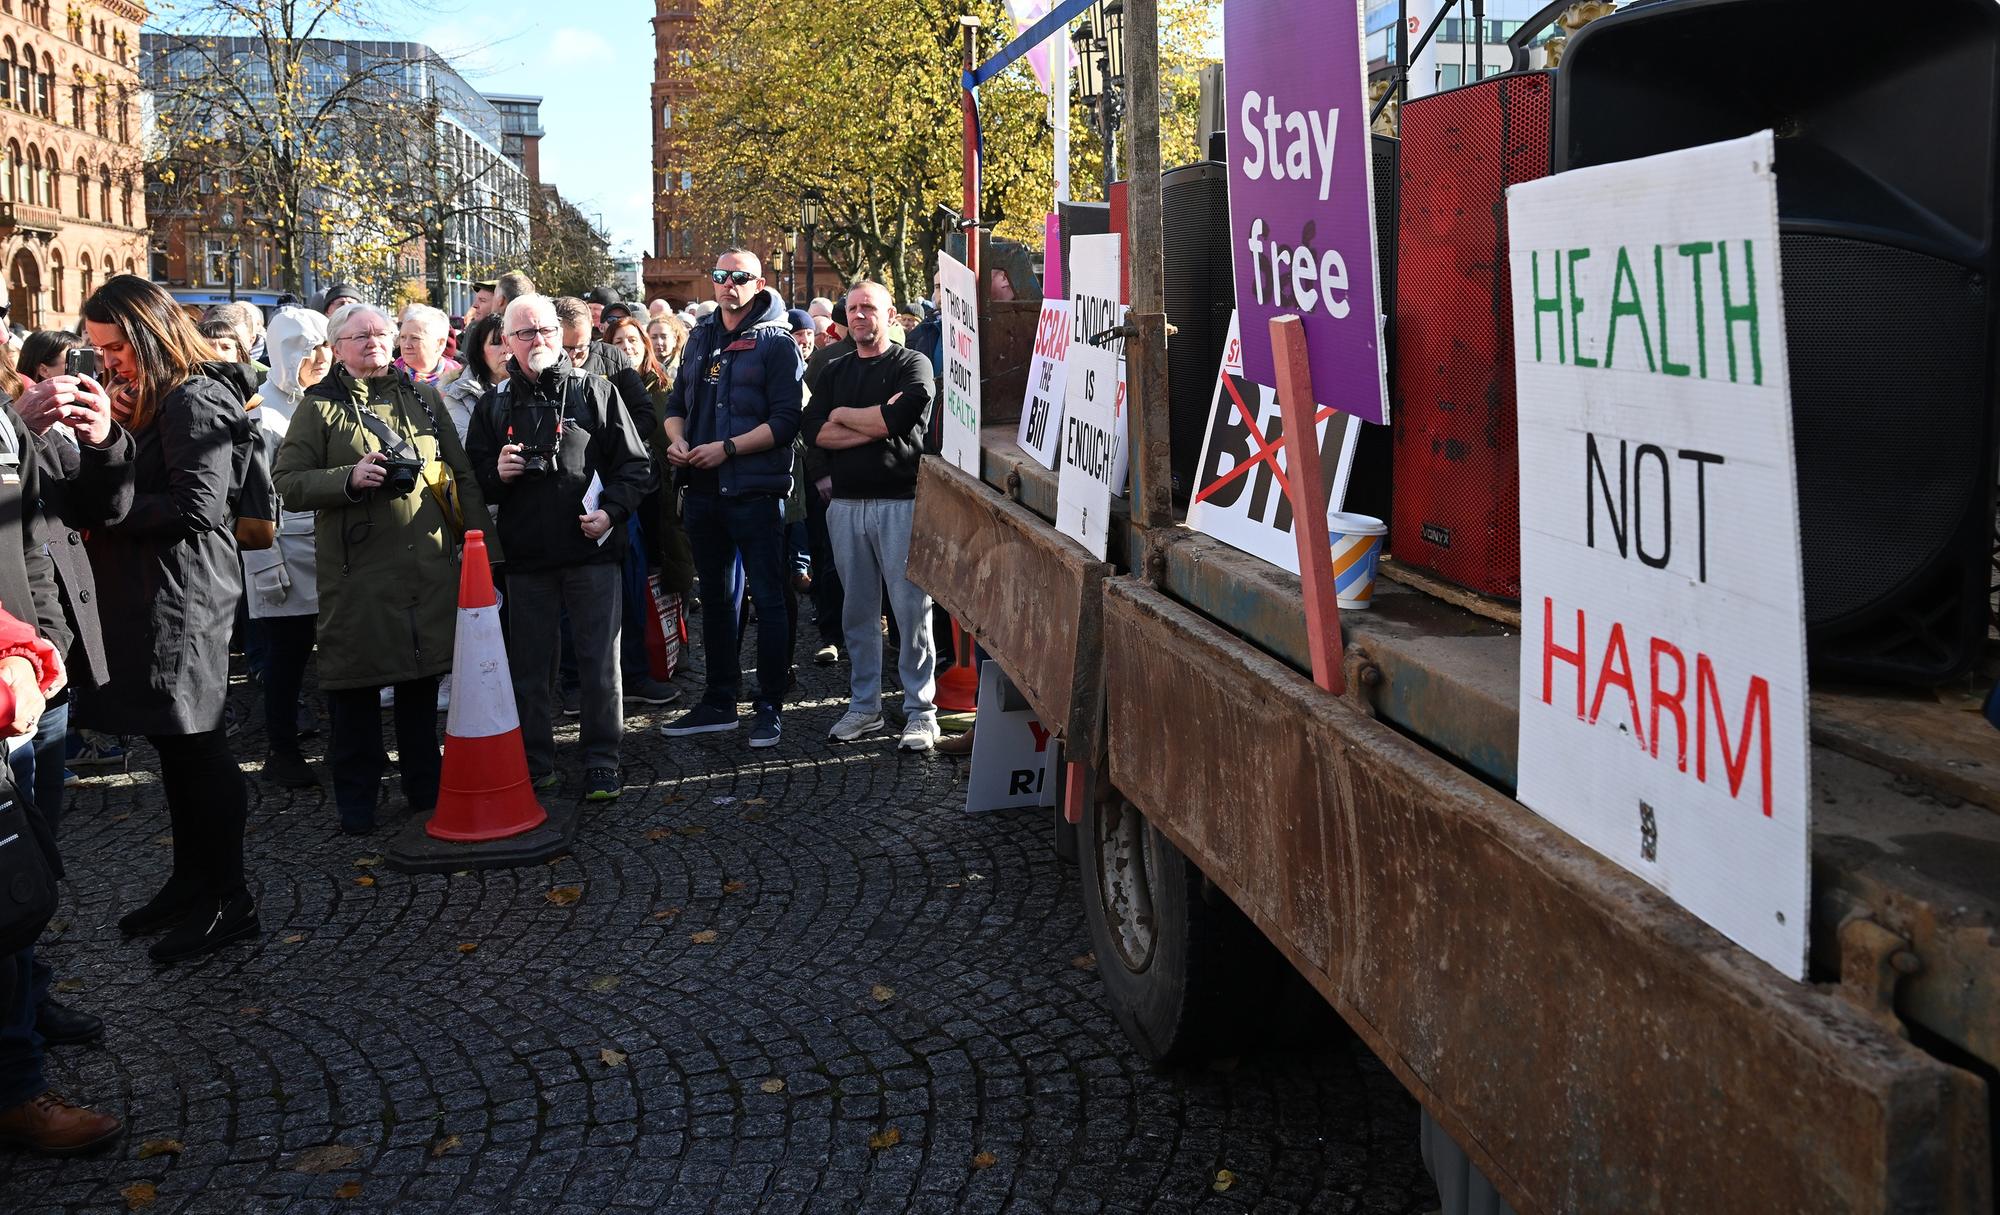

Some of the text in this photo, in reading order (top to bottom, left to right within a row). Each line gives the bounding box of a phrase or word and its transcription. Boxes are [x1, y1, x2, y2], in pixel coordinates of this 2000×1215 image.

[1241, 90, 1339, 200] Stay
[1248, 218, 1350, 319] free
[945, 287, 976, 333] THIS BILL
[1074, 293, 1116, 353] ENOUGH
[1532, 239, 1763, 386] HEALTH
[949, 322, 972, 363] IS NOT
[949, 357, 972, 397] ABOUT
[1039, 360, 1053, 393] THE
[1085, 368, 1095, 402] IS
[947, 386, 976, 435] HEALTH
[1026, 395, 1050, 452] Bill
[1066, 416, 1111, 485] ENOUGH
[1586, 432, 1725, 583] NOT
[1542, 596, 1773, 818] HARM
